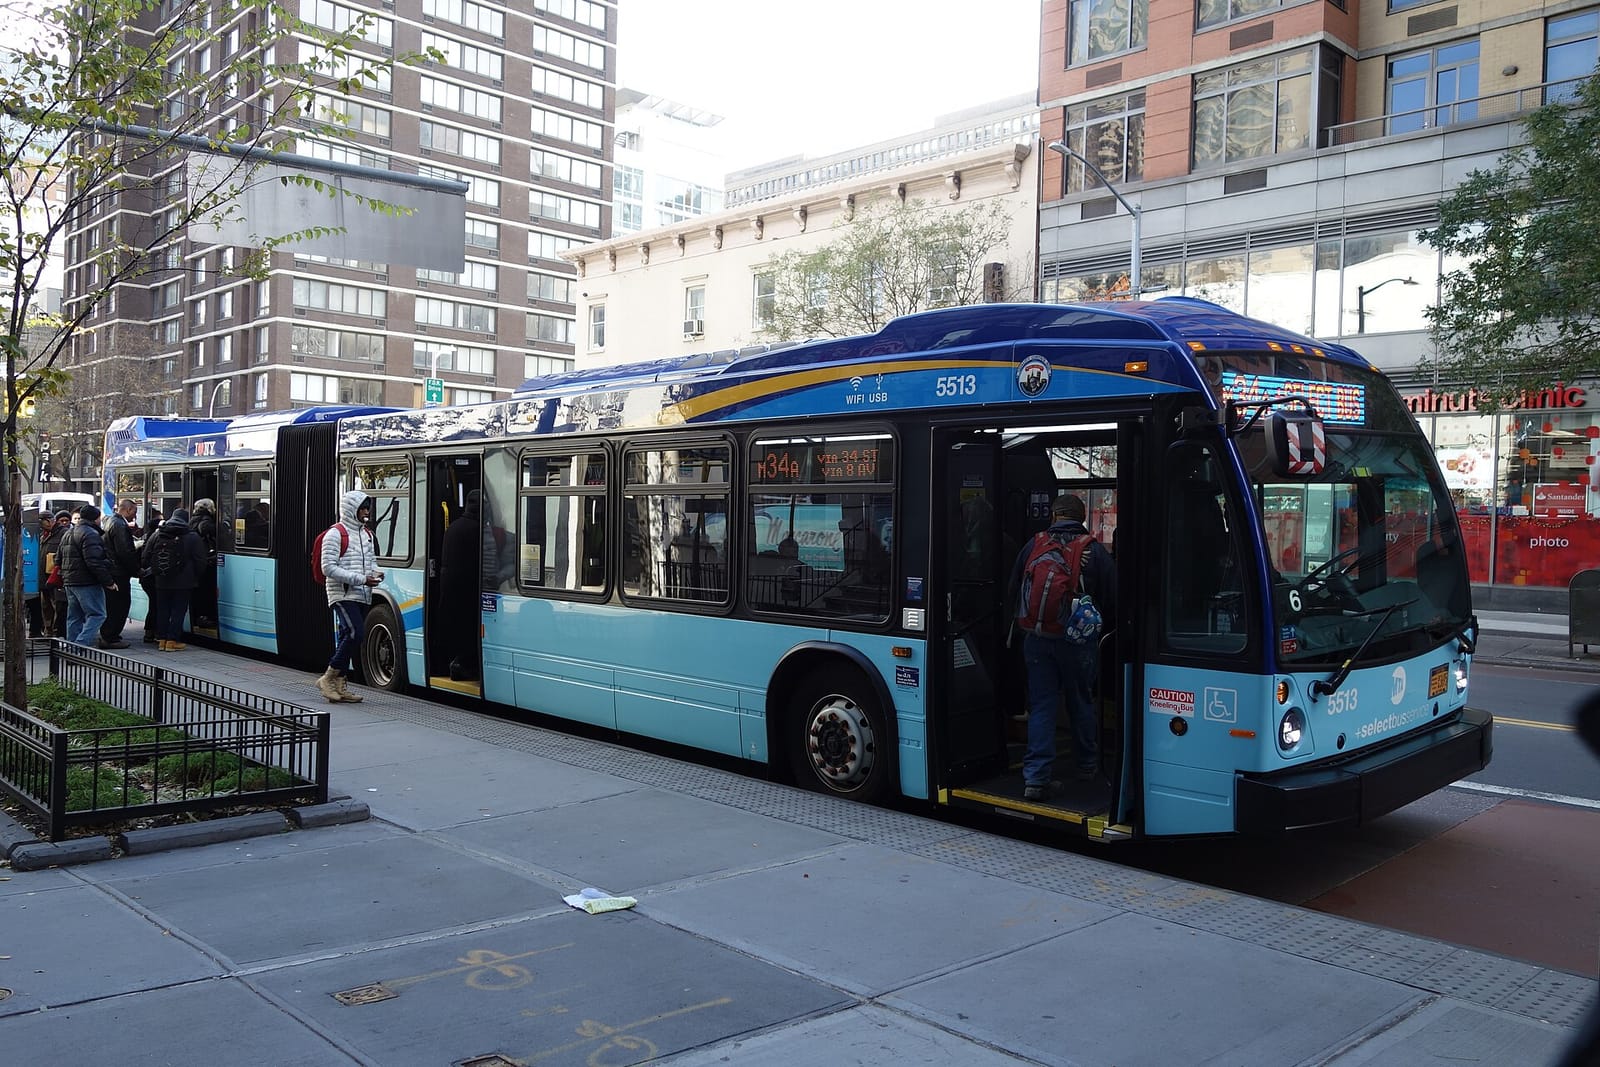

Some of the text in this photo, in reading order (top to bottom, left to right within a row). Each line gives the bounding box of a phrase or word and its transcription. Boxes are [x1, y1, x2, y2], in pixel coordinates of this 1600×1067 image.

[935, 374, 976, 397] 5513
[846, 392, 888, 405] WIFI USB
[40, 441, 49, 482] park
[817, 449, 879, 464] VIA 34 ST
[757, 451, 799, 478] M34A
[822, 463, 876, 478] VIA 8 AV
[1547, 493, 1585, 501] Santander
[1530, 536, 1569, 548] photo
[1289, 589, 1302, 611] 6
[1150, 688, 1194, 703] CAUTION
[1327, 688, 1358, 715] 5513
[1150, 700, 1194, 712] Kneeling Bus
